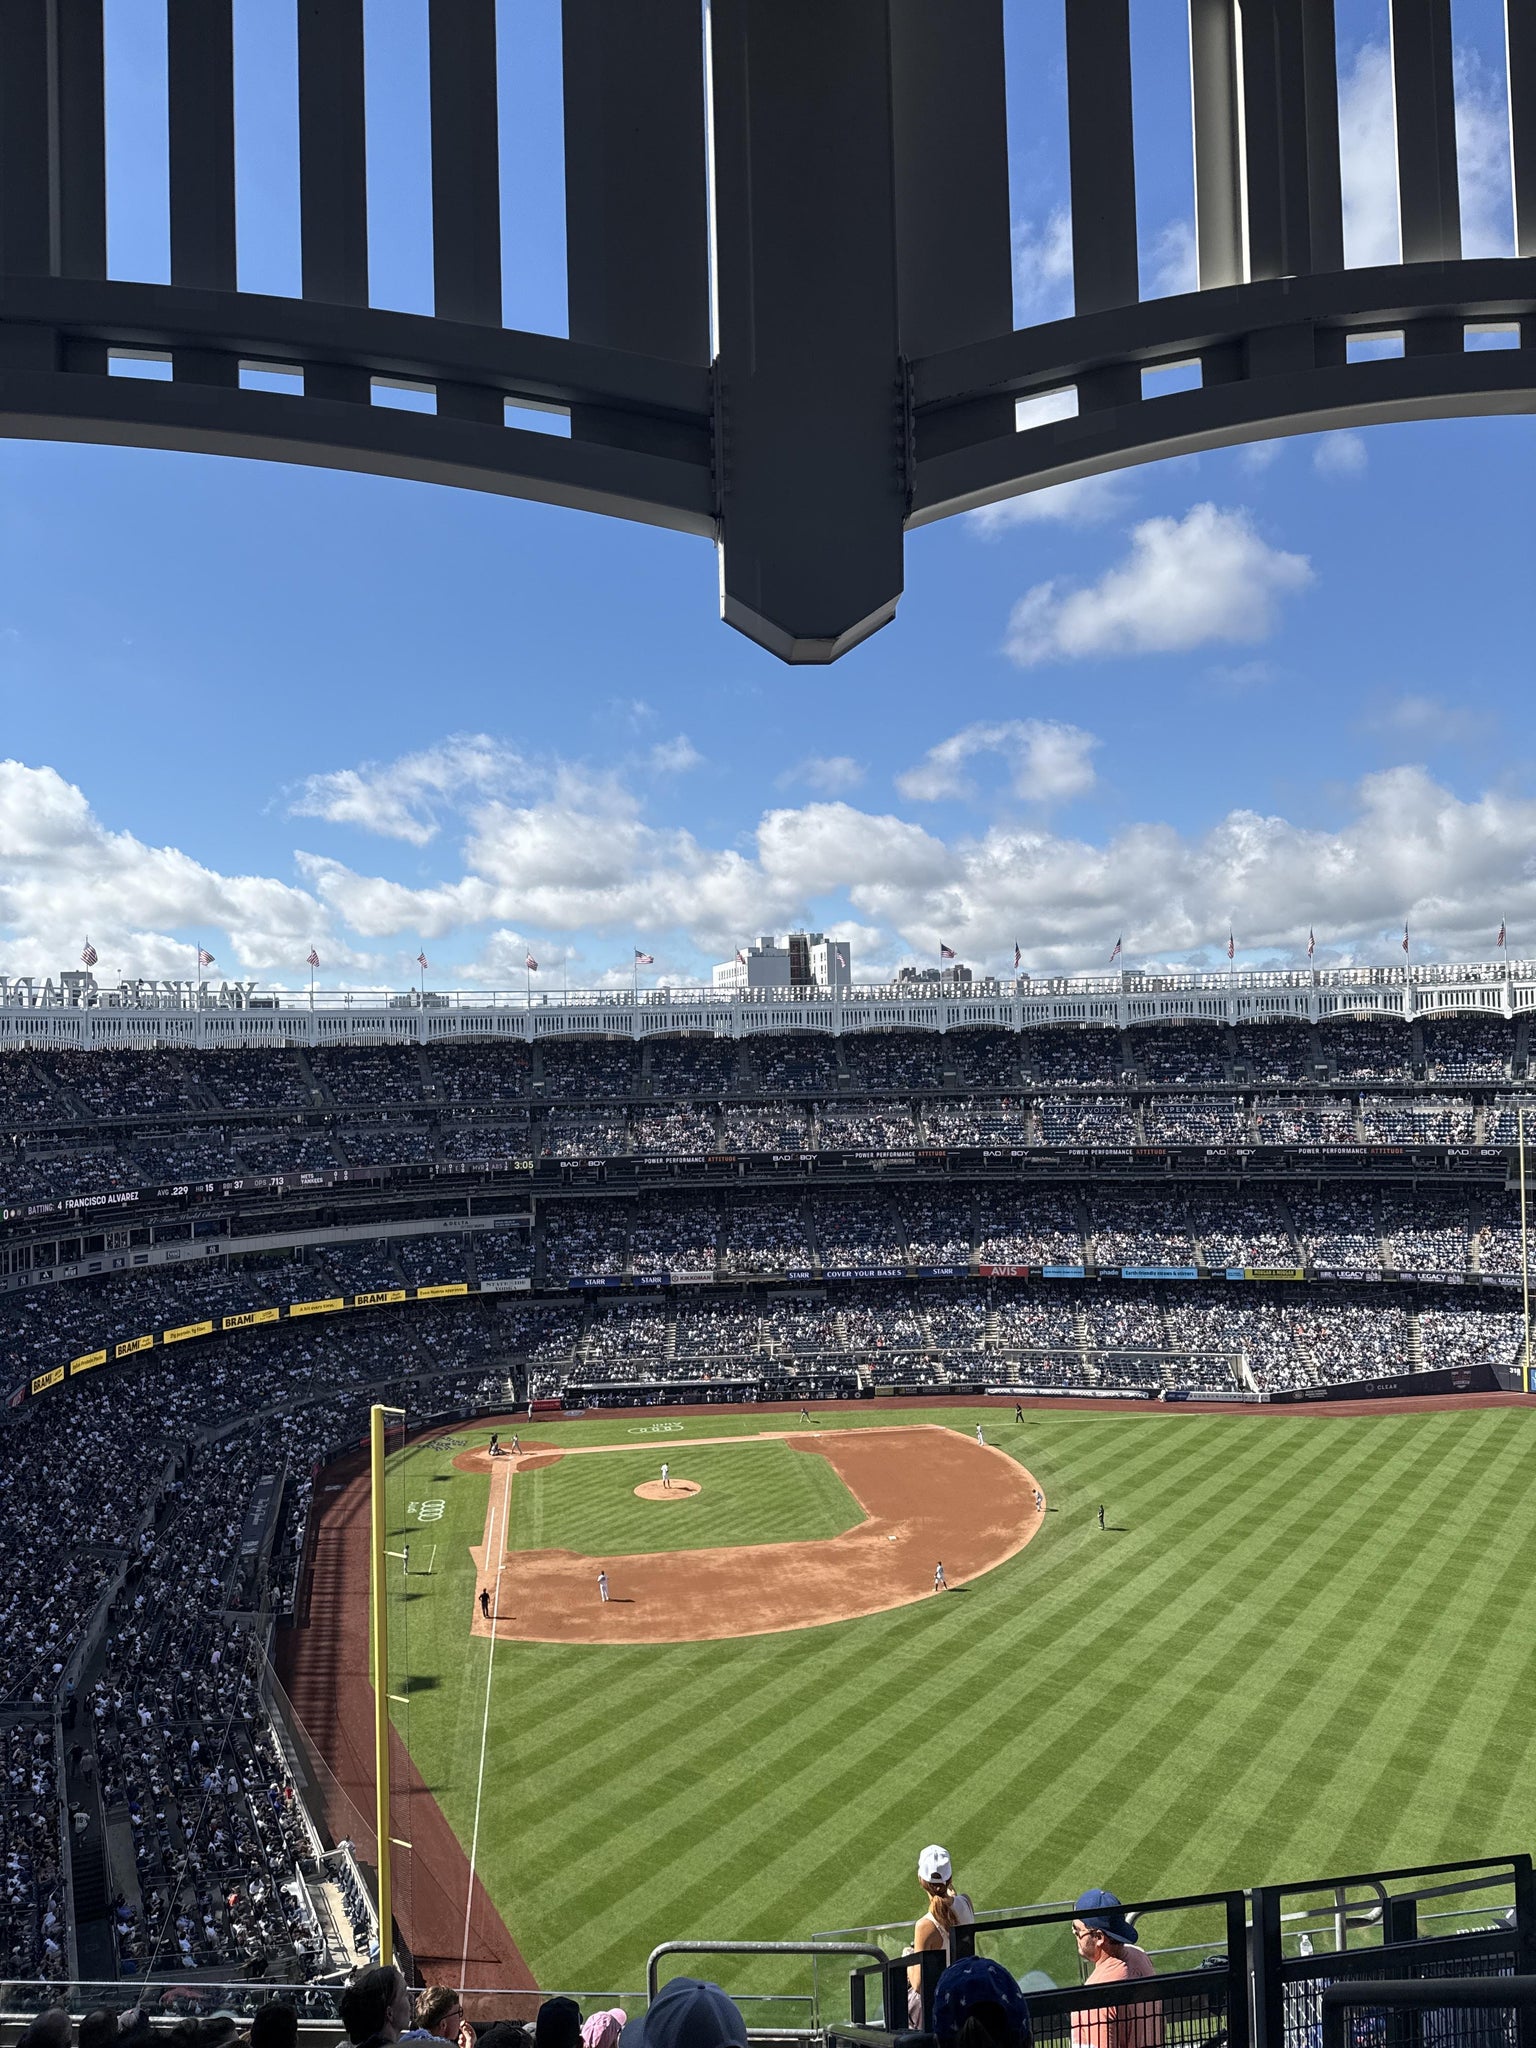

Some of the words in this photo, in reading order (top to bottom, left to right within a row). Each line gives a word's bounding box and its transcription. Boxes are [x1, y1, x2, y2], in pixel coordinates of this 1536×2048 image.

[514, 1161, 533, 1169] 3:05
[234, 1180, 244, 1189] 37
[268, 1177, 284, 1186] .713
[171, 1186, 189, 1196] .229
[205, 1184, 214, 1192] 15
[28, 1203, 55, 1215] BATTING:
[57, 1201, 62, 1210] 4
[65, 1195, 107, 1209] FRANCISCO
[107, 1191, 139, 1204] ALVAREZ
[3, 1209, 9, 1219] 0
[990, 1267, 1017, 1276] AVIS
[357, 1294, 387, 1305] BRAMI
[225, 1314, 254, 1328] BRAMI
[118, 1341, 140, 1356] BRAMI
[33, 1373, 53, 1392] BRAMI
